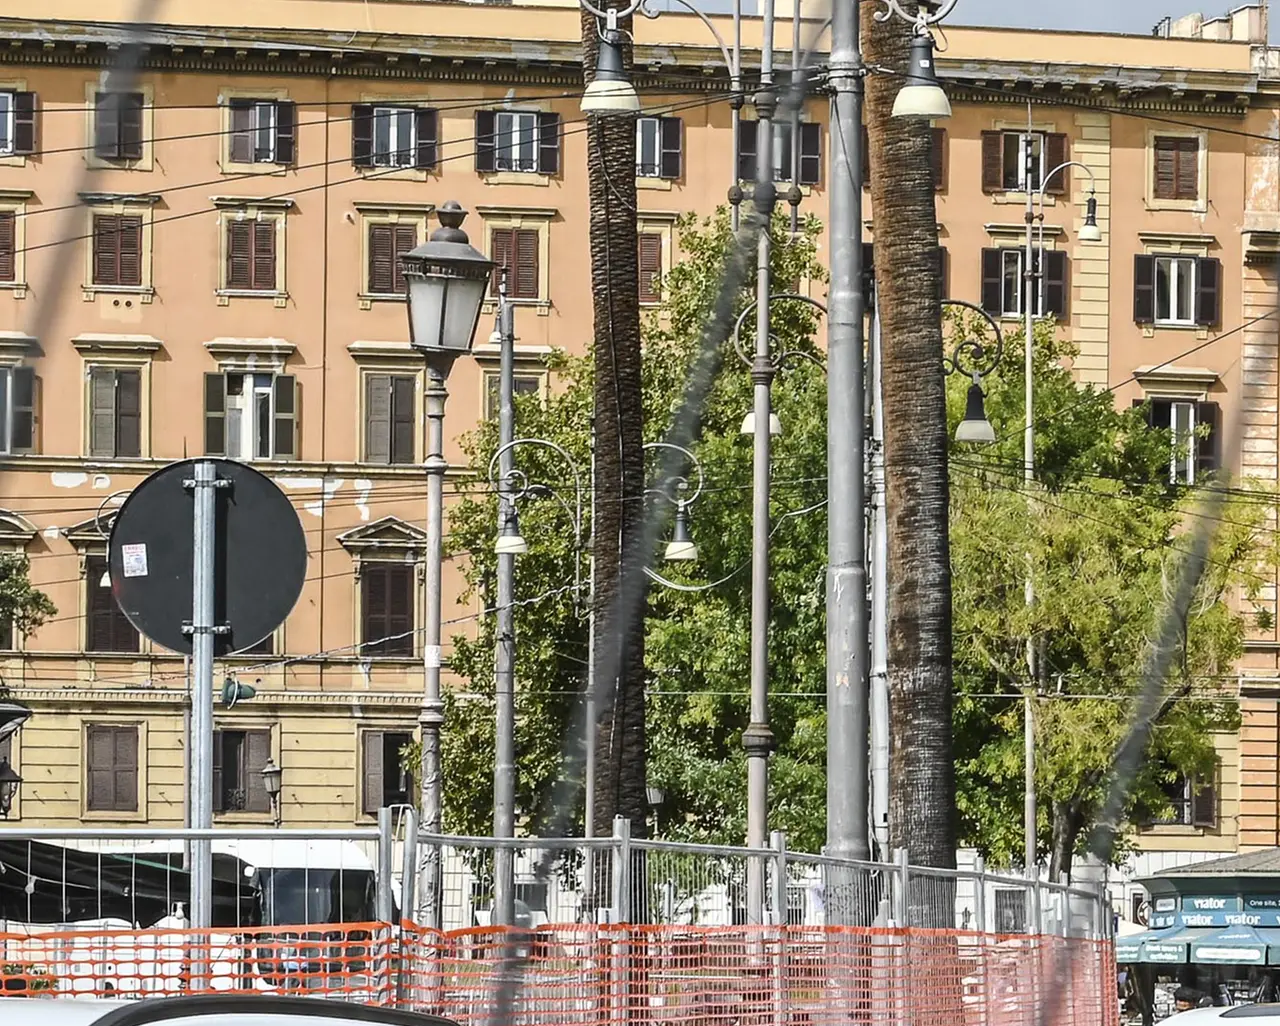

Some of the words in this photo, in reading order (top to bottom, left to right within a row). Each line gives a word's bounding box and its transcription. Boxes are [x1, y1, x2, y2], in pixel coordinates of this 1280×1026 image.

[1194, 897, 1226, 909] viator
[1182, 914, 1213, 925] viator
[1225, 914, 1261, 926] viator
